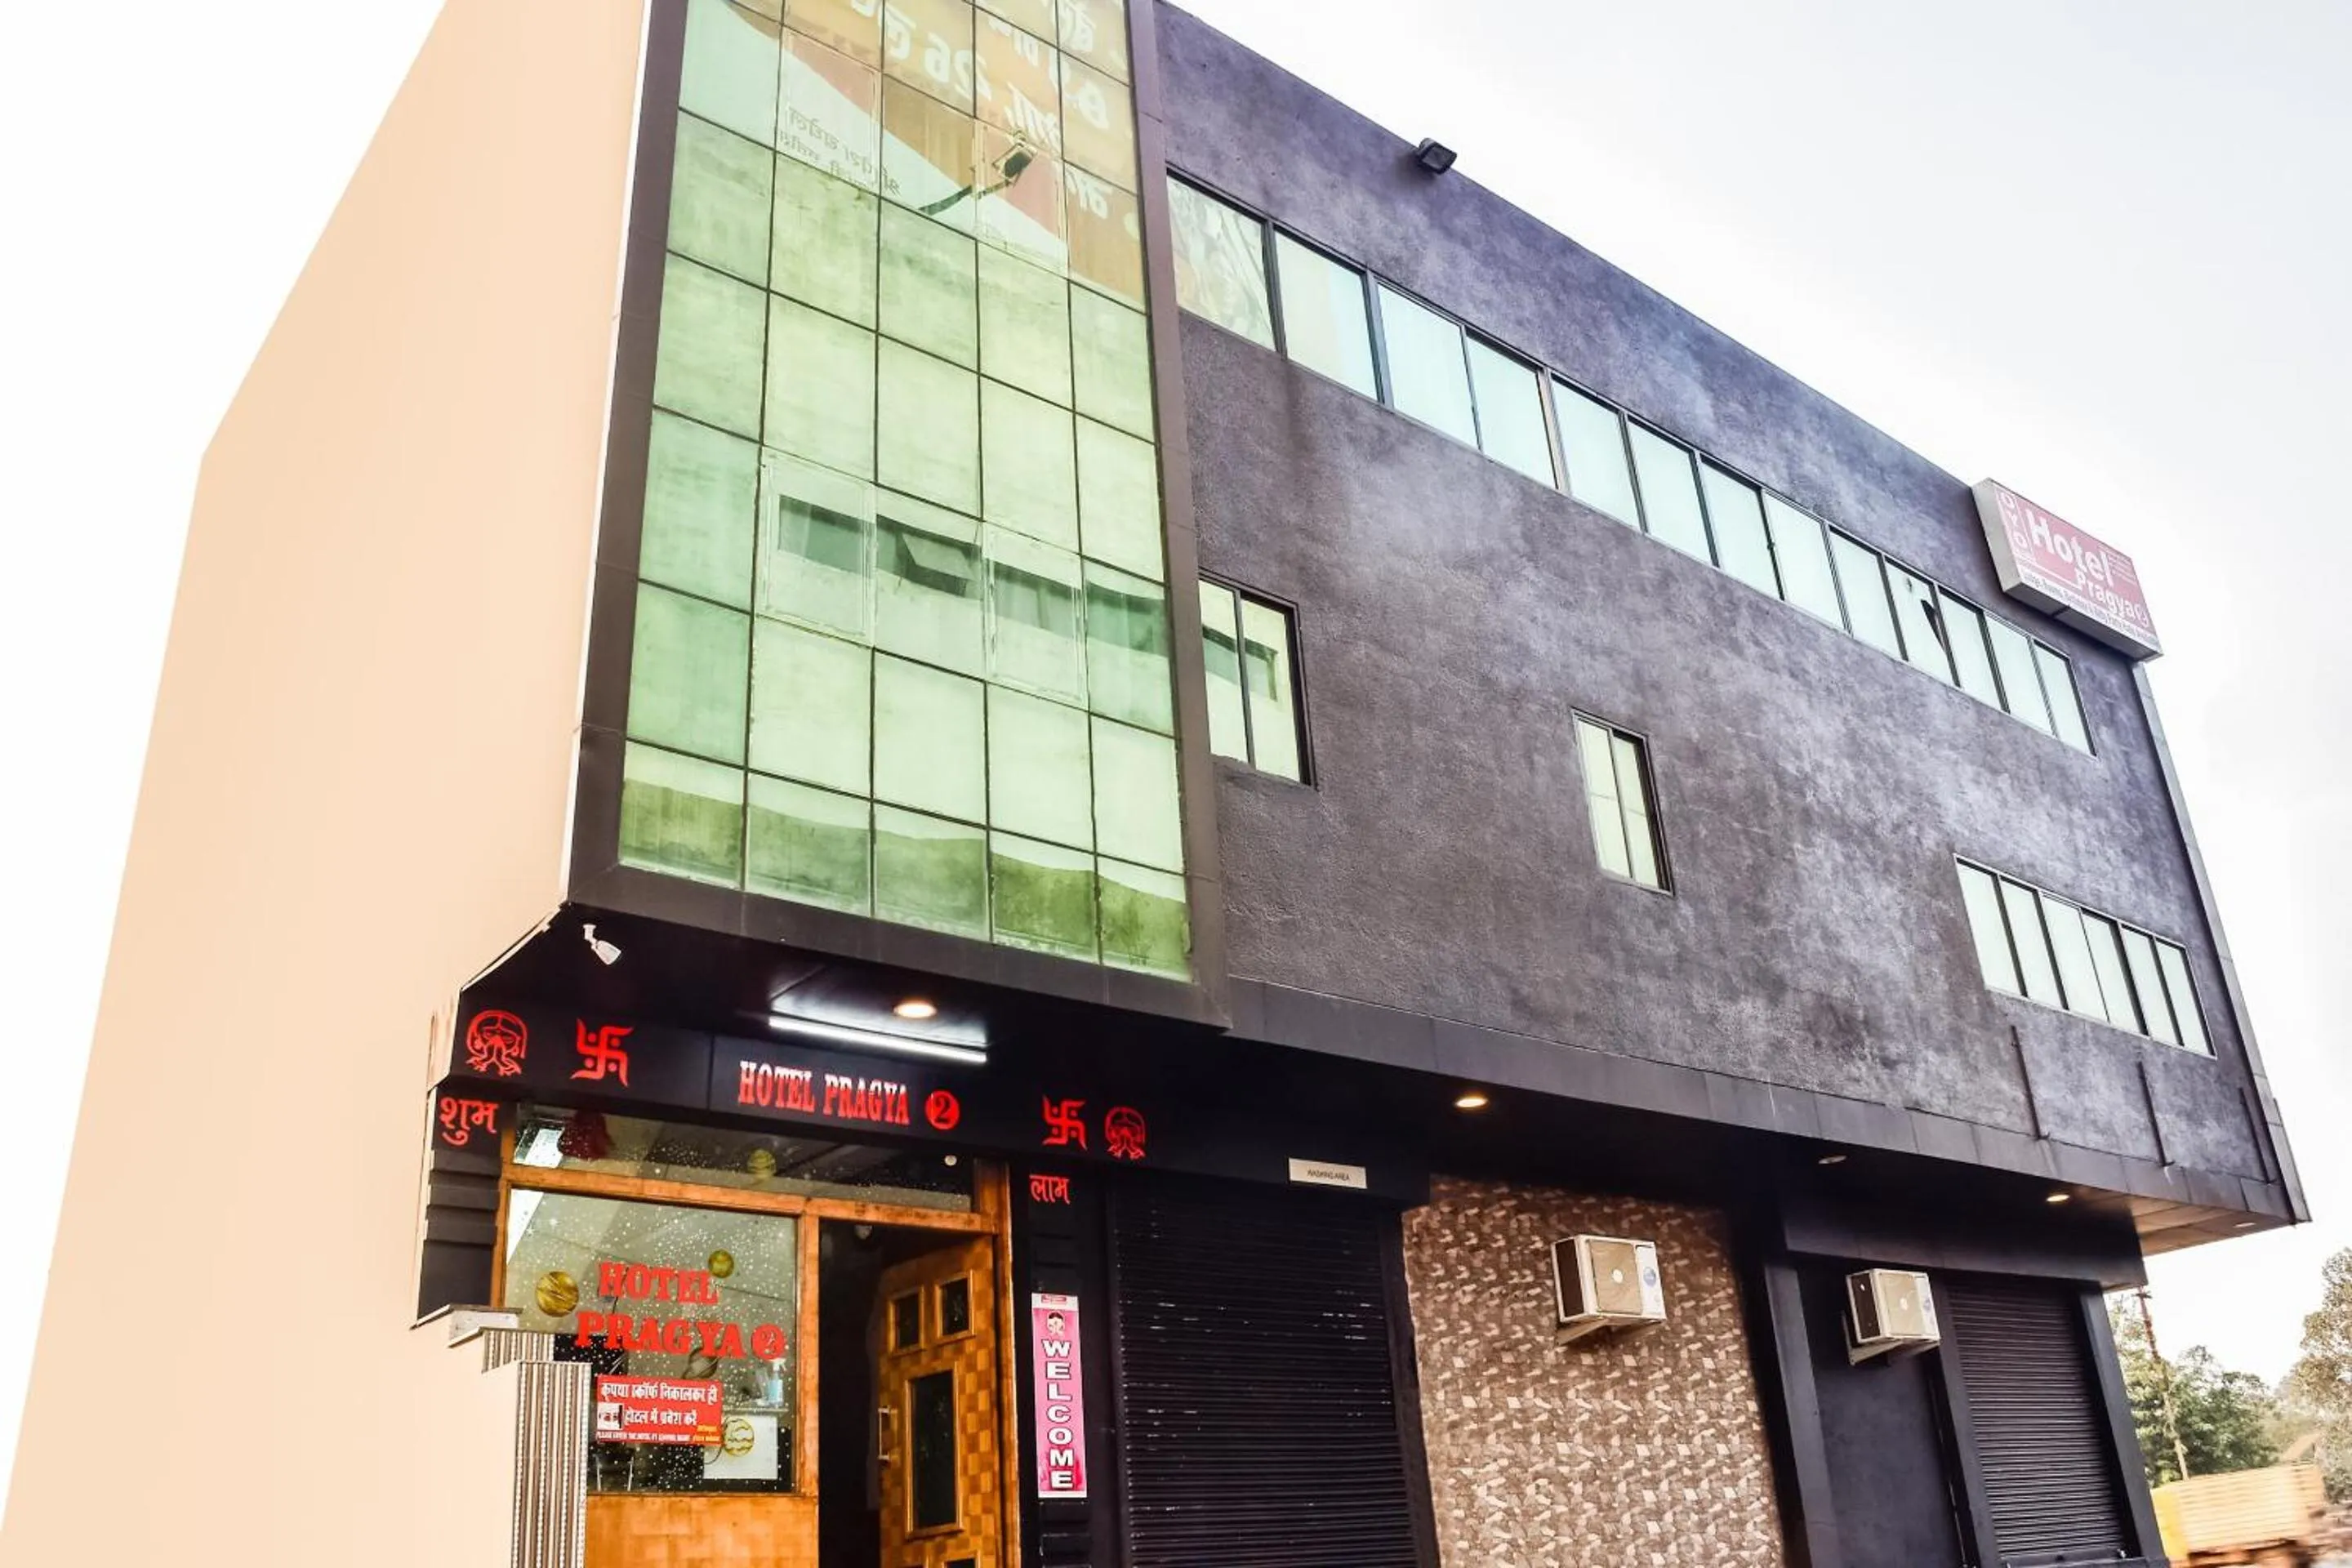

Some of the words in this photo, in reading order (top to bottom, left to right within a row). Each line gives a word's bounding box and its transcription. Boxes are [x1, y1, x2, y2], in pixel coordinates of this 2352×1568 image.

[2025, 508, 2114, 590] Hotel
[2074, 567, 2136, 619] Pragya
[738, 1061, 816, 1113] HOTEL
[823, 1072, 911, 1126] PRAGYA
[598, 1260, 719, 1306] HOTEL
[575, 1310, 746, 1360] PRAGYA
[1041, 1339, 1076, 1490] WELCOME
